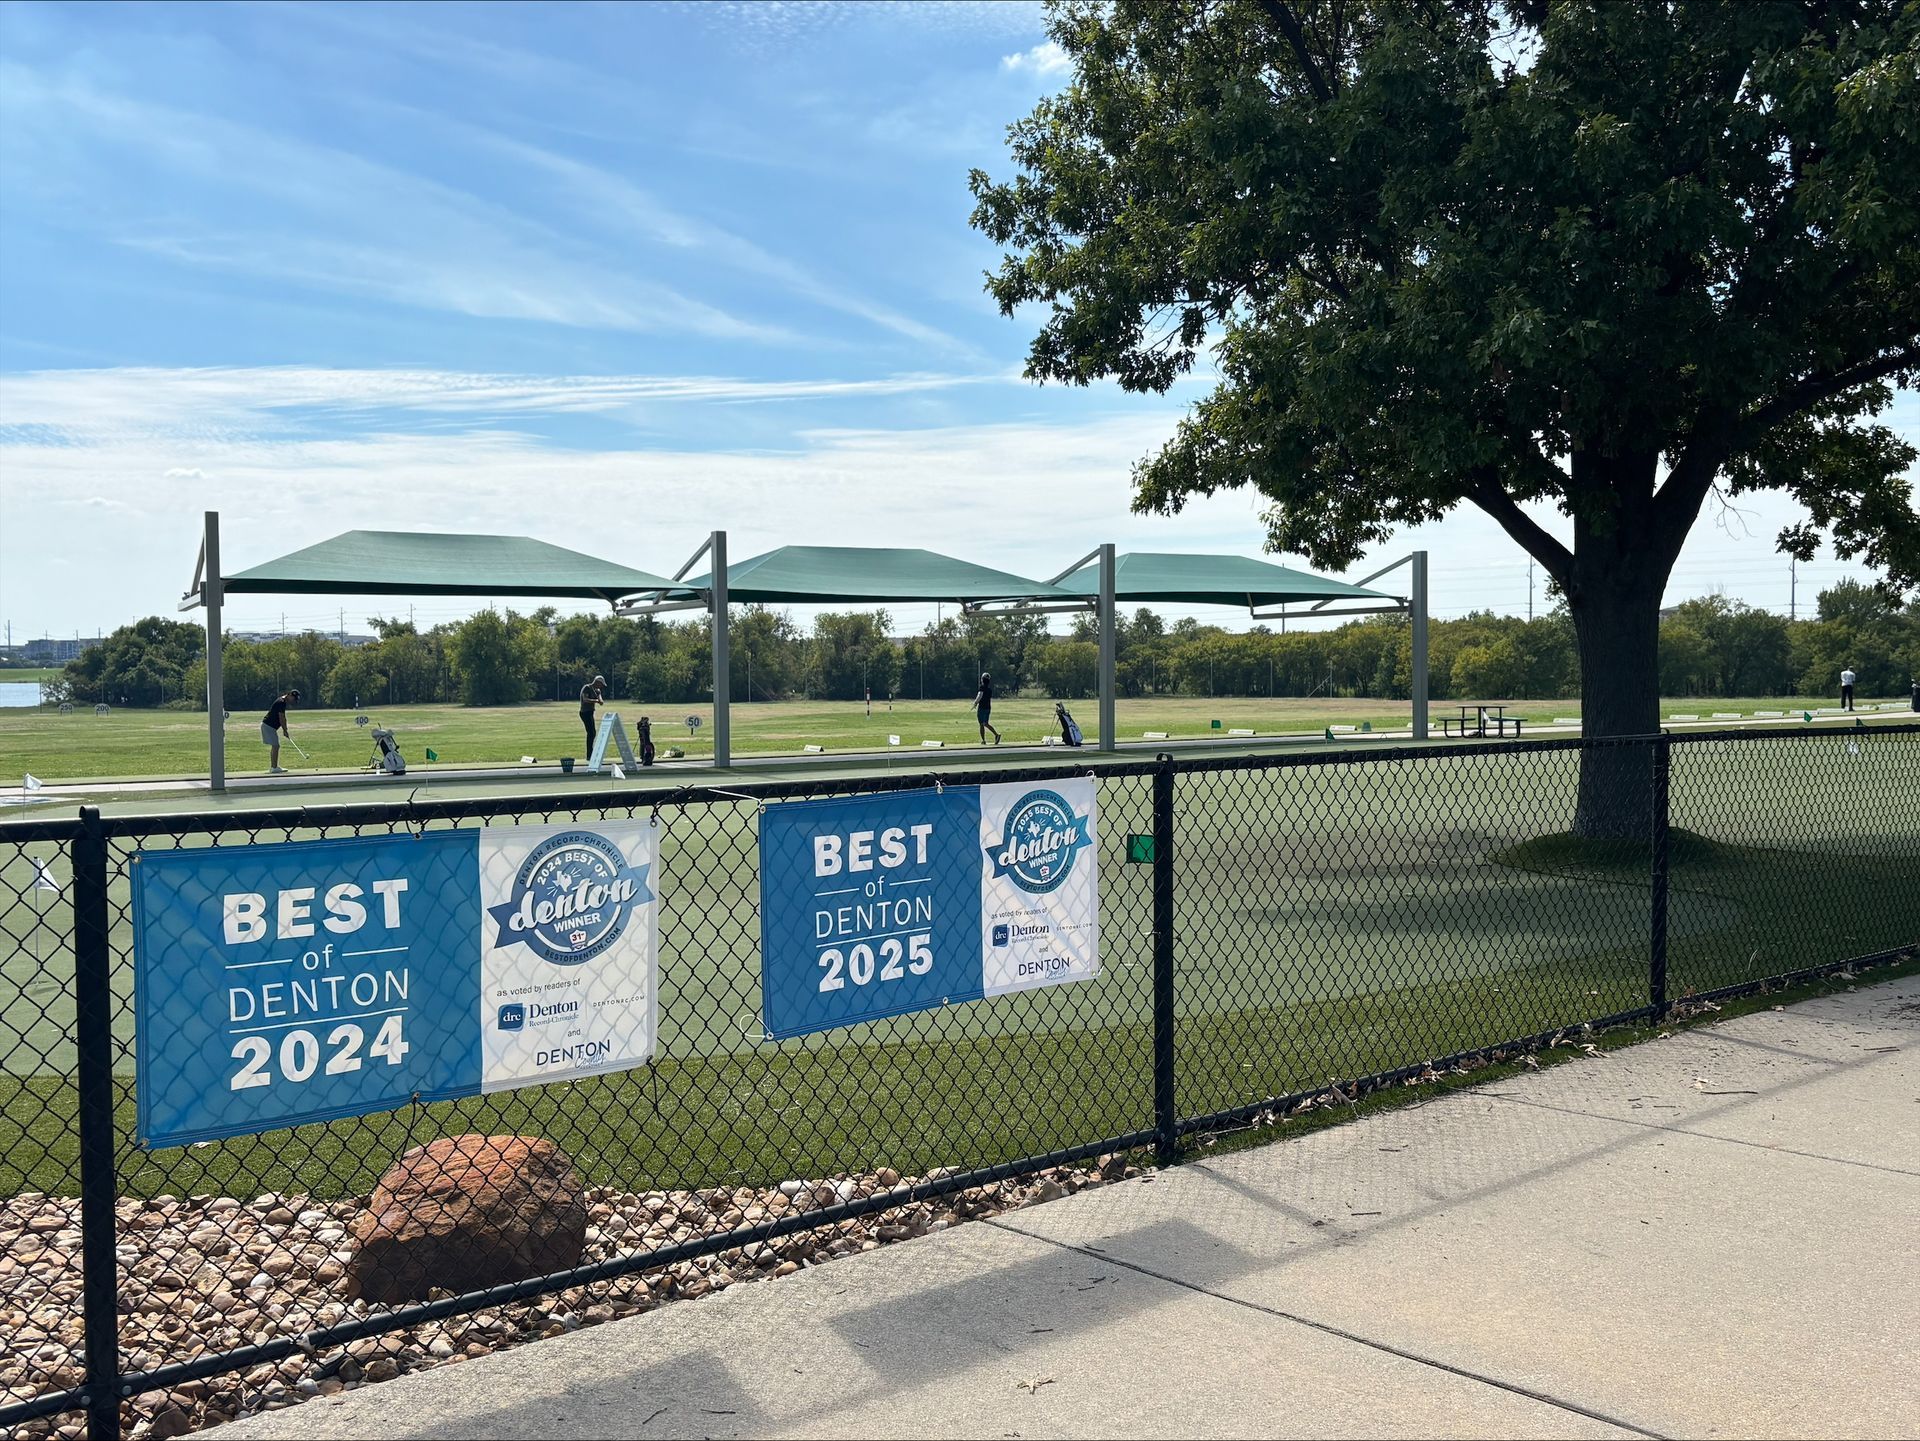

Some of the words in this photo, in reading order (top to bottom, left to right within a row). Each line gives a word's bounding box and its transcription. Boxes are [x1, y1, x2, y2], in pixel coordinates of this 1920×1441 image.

[355, 716, 369, 724] 100
[688, 716, 700, 727] 50
[1018, 810, 1033, 832] 2025
[1034, 806, 1053, 817] BEST
[1053, 814, 1063, 826] OF
[814, 823, 933, 877] BEST
[998, 826, 1080, 866] denton
[519, 850, 544, 885] DENTON
[545, 835, 625, 870] RECORD-CHRONICLE
[536, 856, 563, 886] 2024
[564, 852, 595, 867] BEST
[594, 863, 609, 879] OF
[1029, 852, 1058, 869] WINNER
[865, 875, 885, 898] of
[223, 879, 409, 945] BEST
[508, 877, 638, 932] denton
[815, 895, 932, 939] DENTON
[553, 912, 602, 933] WINNER
[1011, 924, 1050, 937] Denton
[302, 944, 333, 972] of
[545, 927, 622, 962] BESTOFDENTON.COM
[818, 933, 934, 993] 2025
[1018, 956, 1070, 976] DENTON
[229, 968, 409, 1022] DENTON
[496, 989, 507, 997] as
[510, 984, 533, 996] voted
[534, 984, 542, 994] by
[544, 979, 571, 991] readers
[573, 978, 581, 986] of
[502, 1012, 521, 1022] drc
[529, 1000, 578, 1018] Denton
[567, 1028, 581, 1037] and
[230, 1015, 409, 1092] 2024
[536, 1039, 611, 1066] DENTON
